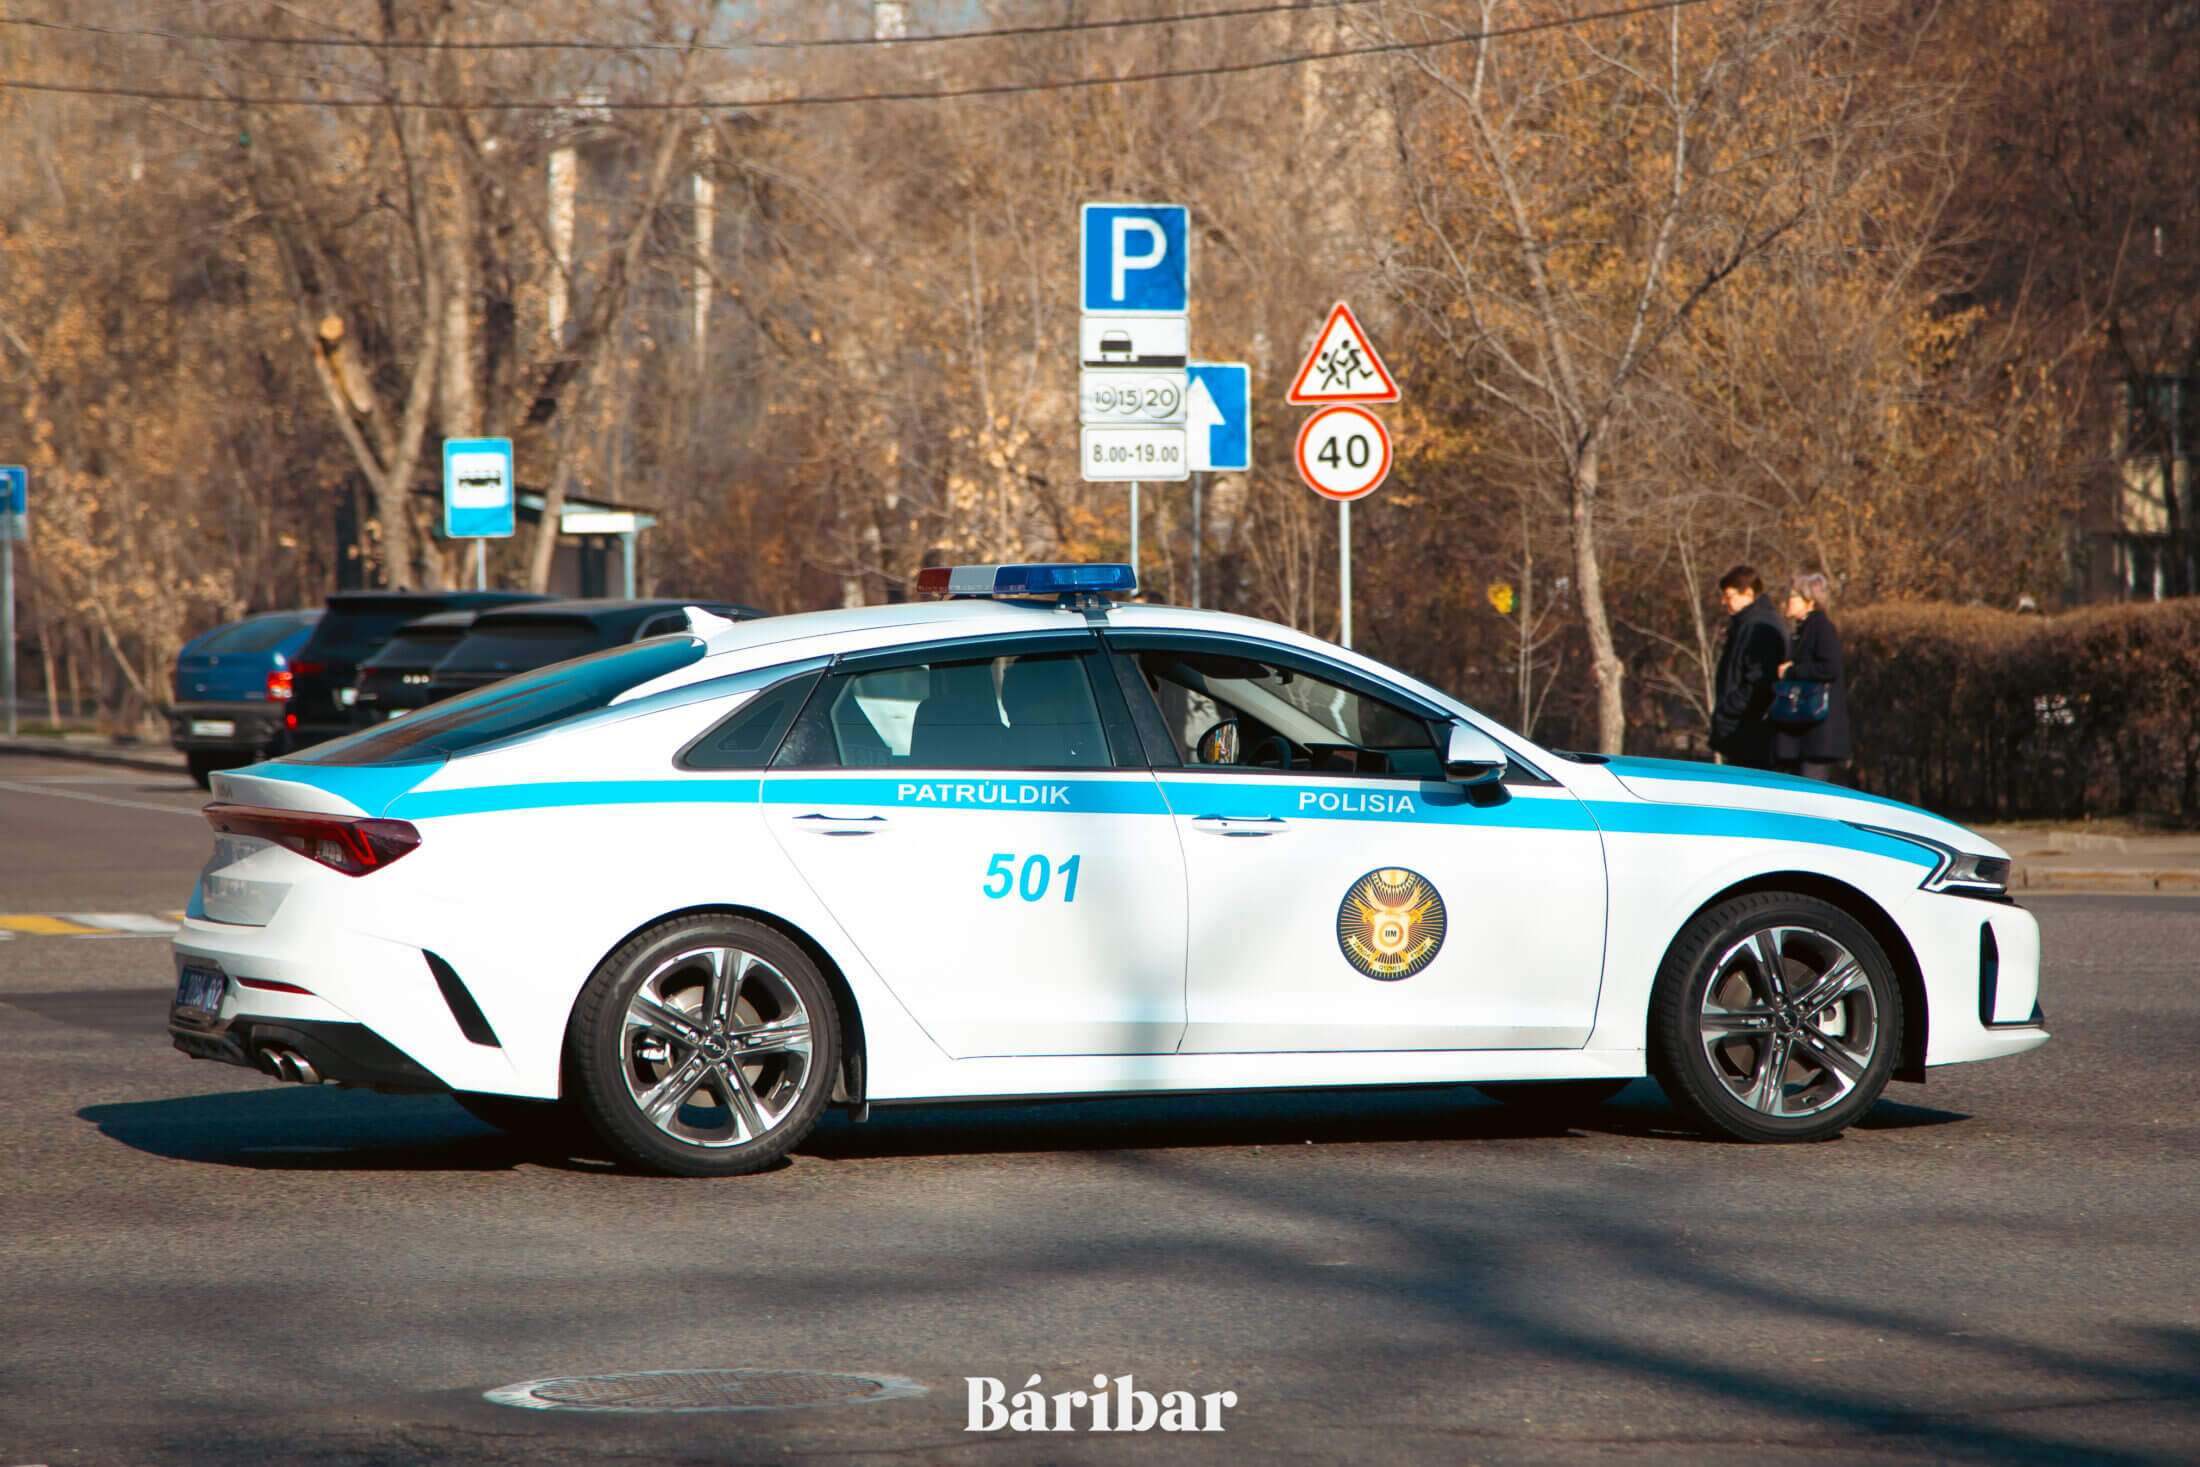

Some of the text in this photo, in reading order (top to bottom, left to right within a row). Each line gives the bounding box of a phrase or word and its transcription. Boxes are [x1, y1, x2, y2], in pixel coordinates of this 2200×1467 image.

[1112, 217, 1167, 301] P
[1119, 390, 1137, 406] 15
[1145, 389, 1174, 406] 20
[1093, 443, 1179, 463] 8.00-19.00
[1318, 434, 1369, 469] 40
[1298, 791, 1416, 814] POLISIA
[983, 853, 1081, 902] 501
